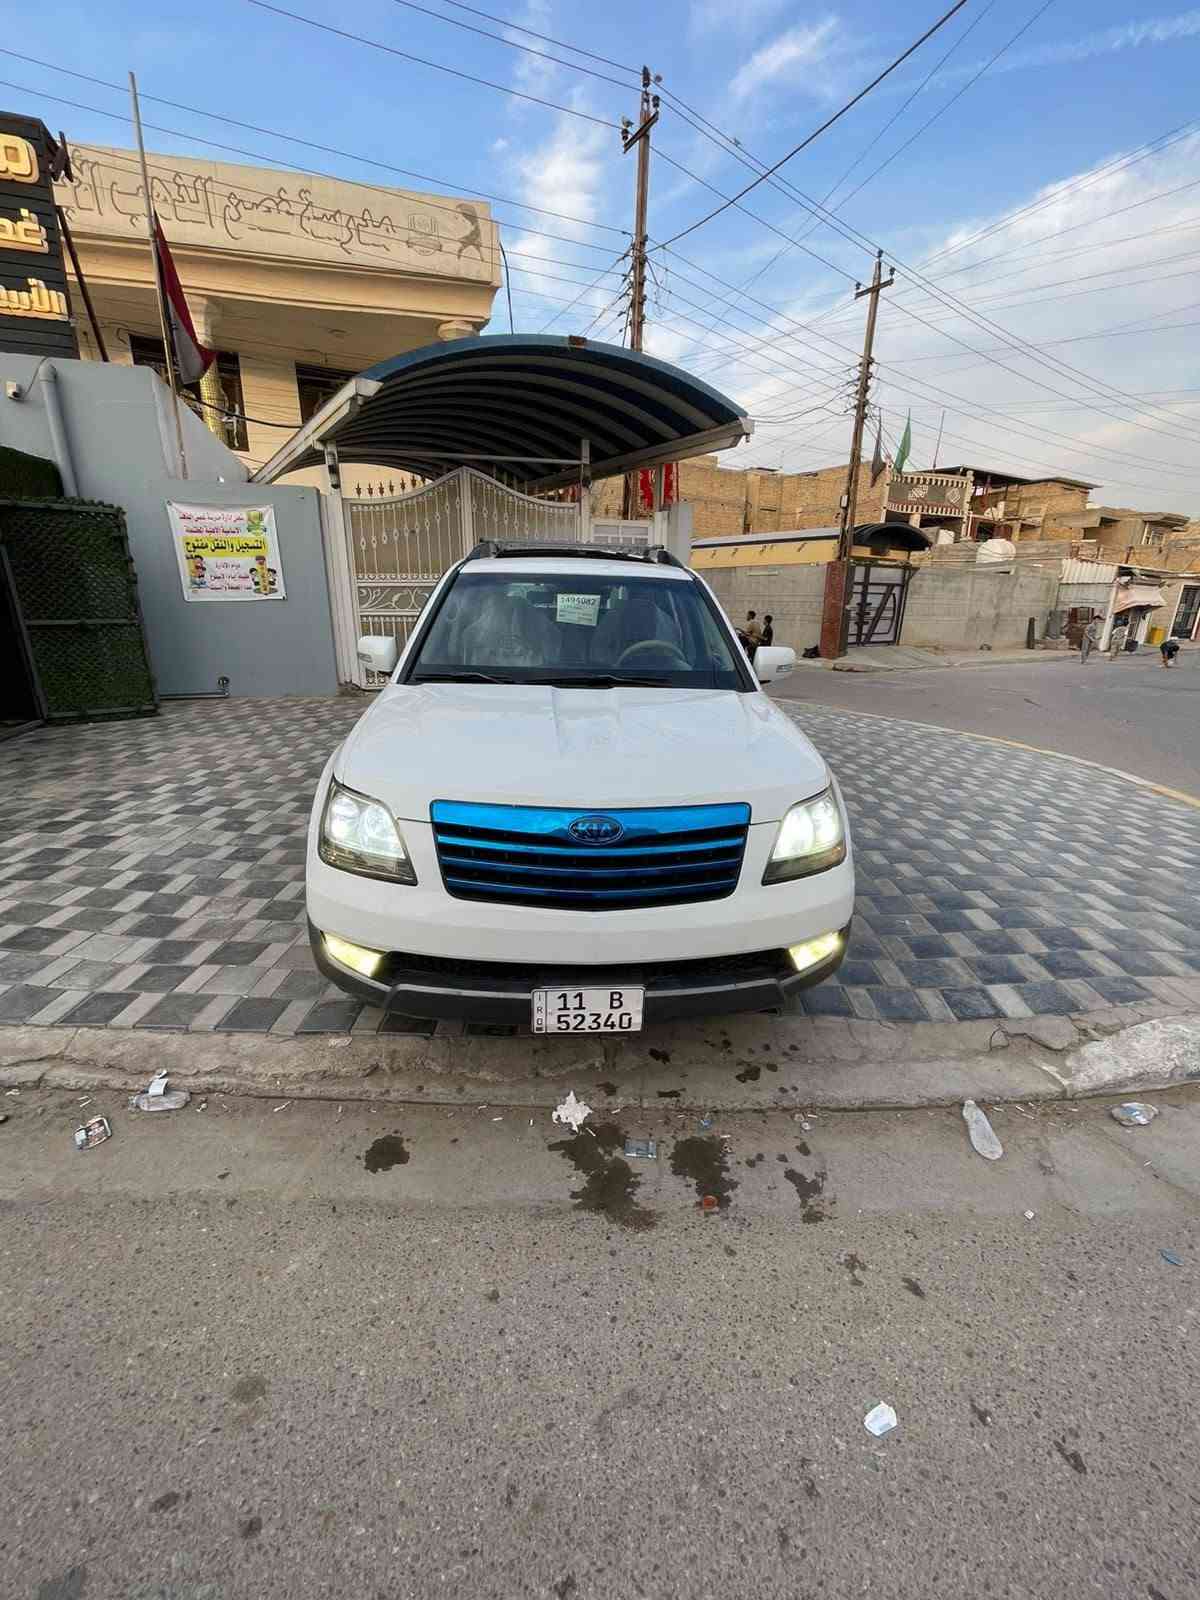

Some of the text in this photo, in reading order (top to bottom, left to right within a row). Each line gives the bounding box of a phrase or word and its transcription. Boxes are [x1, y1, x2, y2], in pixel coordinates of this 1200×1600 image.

[557, 991, 624, 1011] 11 B
[557, 1012, 633, 1031] 52340
